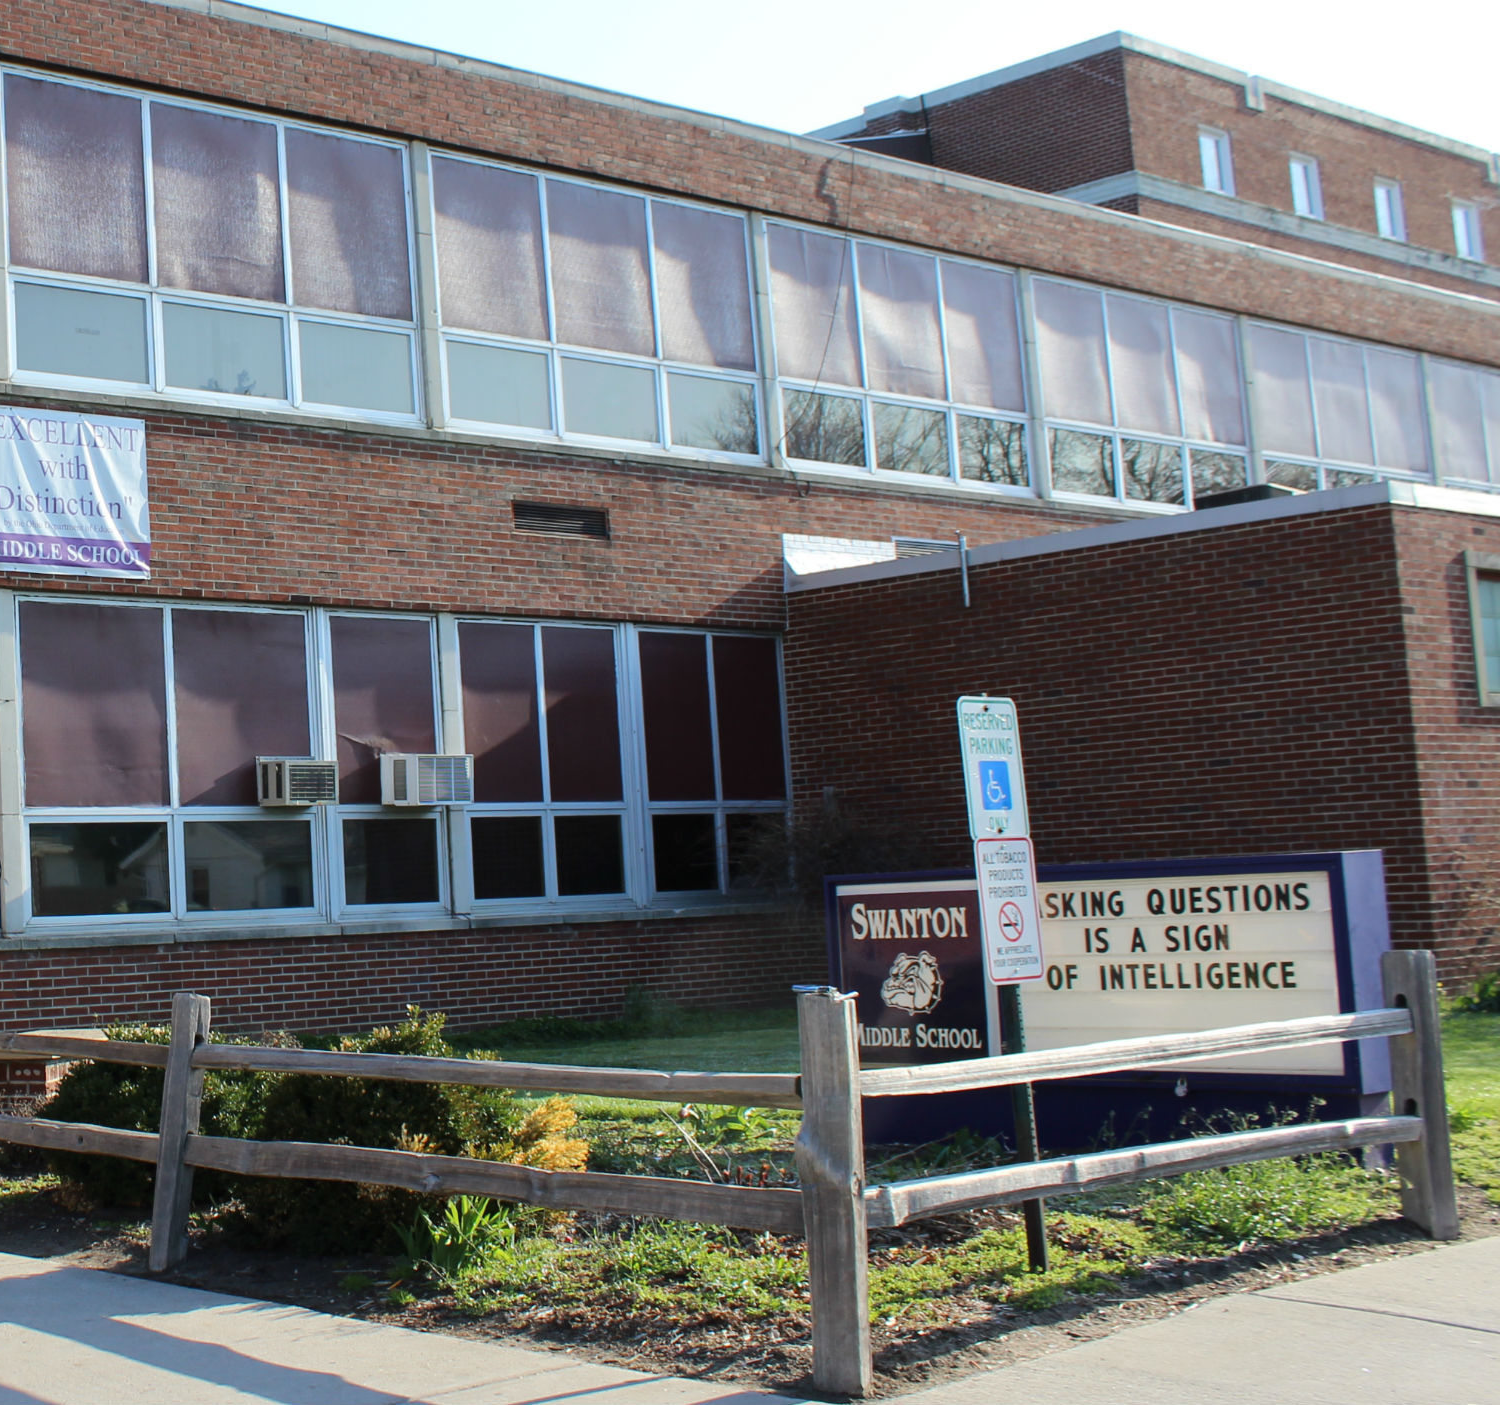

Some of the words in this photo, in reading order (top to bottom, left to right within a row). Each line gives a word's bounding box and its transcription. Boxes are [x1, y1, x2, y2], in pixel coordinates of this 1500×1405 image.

[37, 453, 89, 481] with
[67, 543, 145, 566] SCHOOL
[963, 712, 1013, 731] RESERVED
[969, 736, 1013, 755] PARKING
[989, 816, 1009, 830] ONLY
[982, 852, 996, 864] ALL
[995, 851, 1027, 863] TOBACCO
[988, 868, 1024, 881] PRODUCTS
[988, 885, 1027, 898] PROHIBITED
[1039, 890, 1125, 919] SKING
[1146, 882, 1310, 915] QUESTIONS
[851, 902, 968, 940] SWANTON
[1084, 927, 1109, 953] IS
[1131, 927, 1147, 953] A
[1164, 924, 1230, 952] SIGN
[1046, 964, 1078, 991] OF
[1100, 961, 1297, 991] INTELLIGENCE
[916, 1023, 982, 1049] SCHOOL
